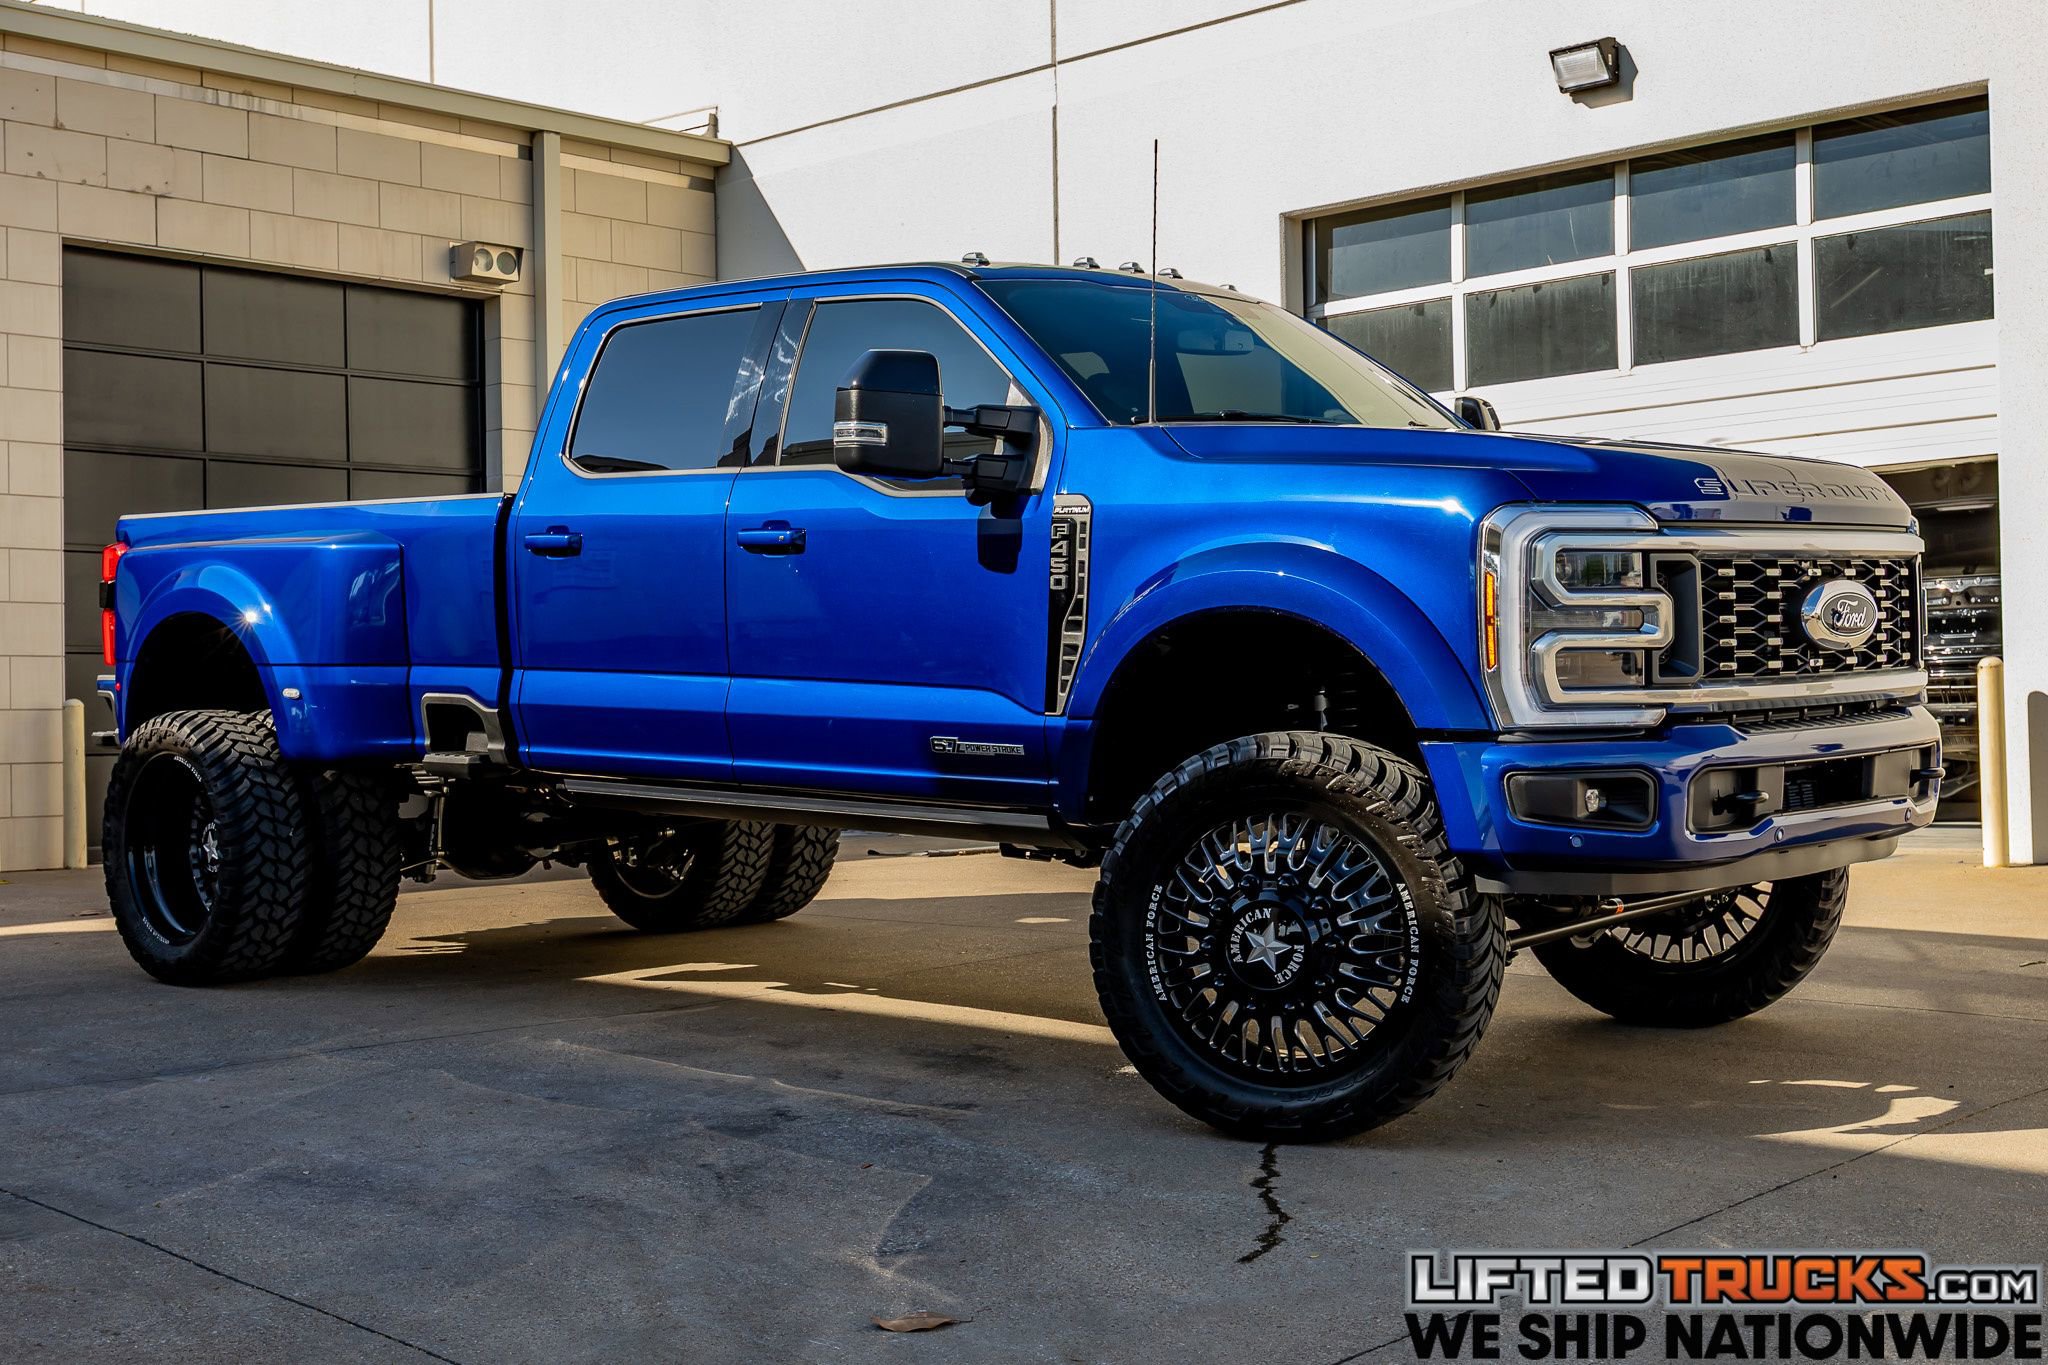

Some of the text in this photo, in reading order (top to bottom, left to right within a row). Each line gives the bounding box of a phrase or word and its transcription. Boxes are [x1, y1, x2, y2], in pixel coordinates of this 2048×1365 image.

[1834, 600, 1867, 628] Ford
[966, 744, 991, 753] POWER
[992, 746, 1022, 754] STROKE
[1146, 884, 1167, 1002] AMERICAN FORCE
[1230, 907, 1306, 986] AMERICAN FORCE
[1395, 882, 1420, 1004] AMERICAN FORCE
